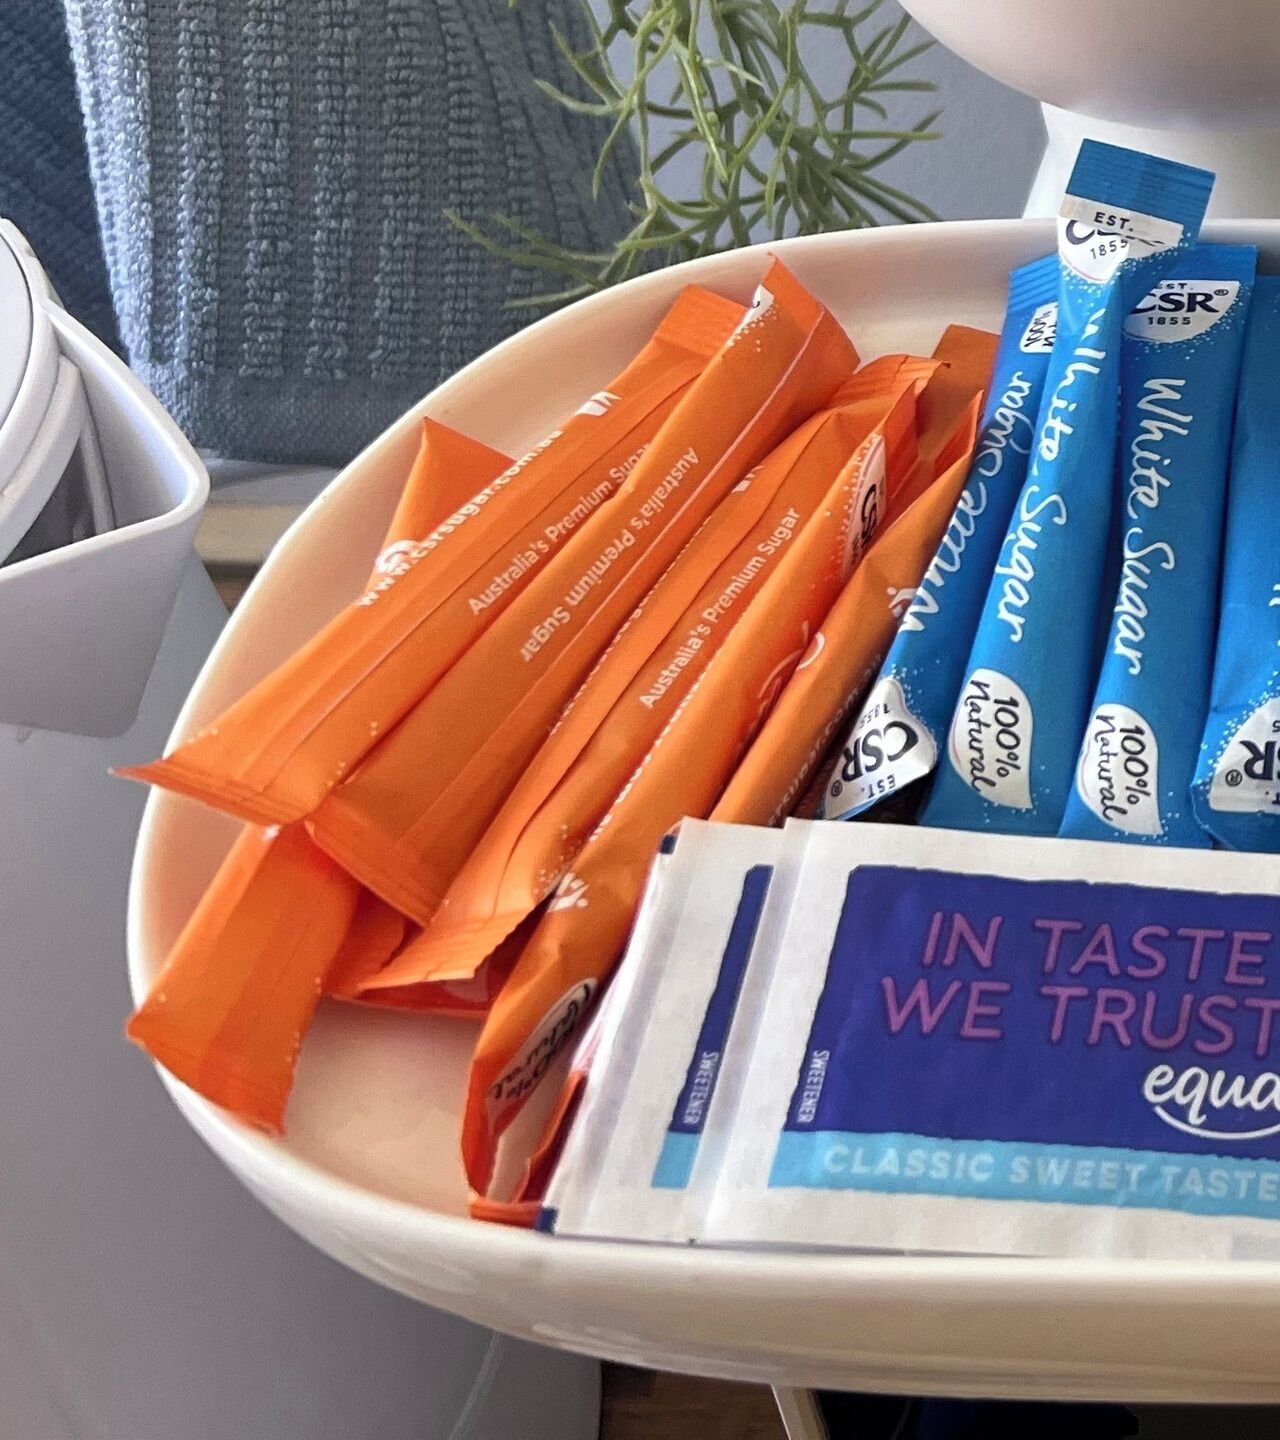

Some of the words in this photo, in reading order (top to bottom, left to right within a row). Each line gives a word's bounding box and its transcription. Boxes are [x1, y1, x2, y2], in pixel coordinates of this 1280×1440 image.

[638, 624, 710, 709] Australia's
[704, 555, 768, 623] Premium
[758, 508, 801, 556] Sugar
[922, 911, 1002, 966] IN
[1034, 918, 1275, 987] TASTE
[881, 975, 1009, 1041] WE
[823, 1144, 998, 1183] CLASSIC
[1009, 1150, 1153, 1195] SWEET
[1158, 1165, 1280, 1202] TASTE
